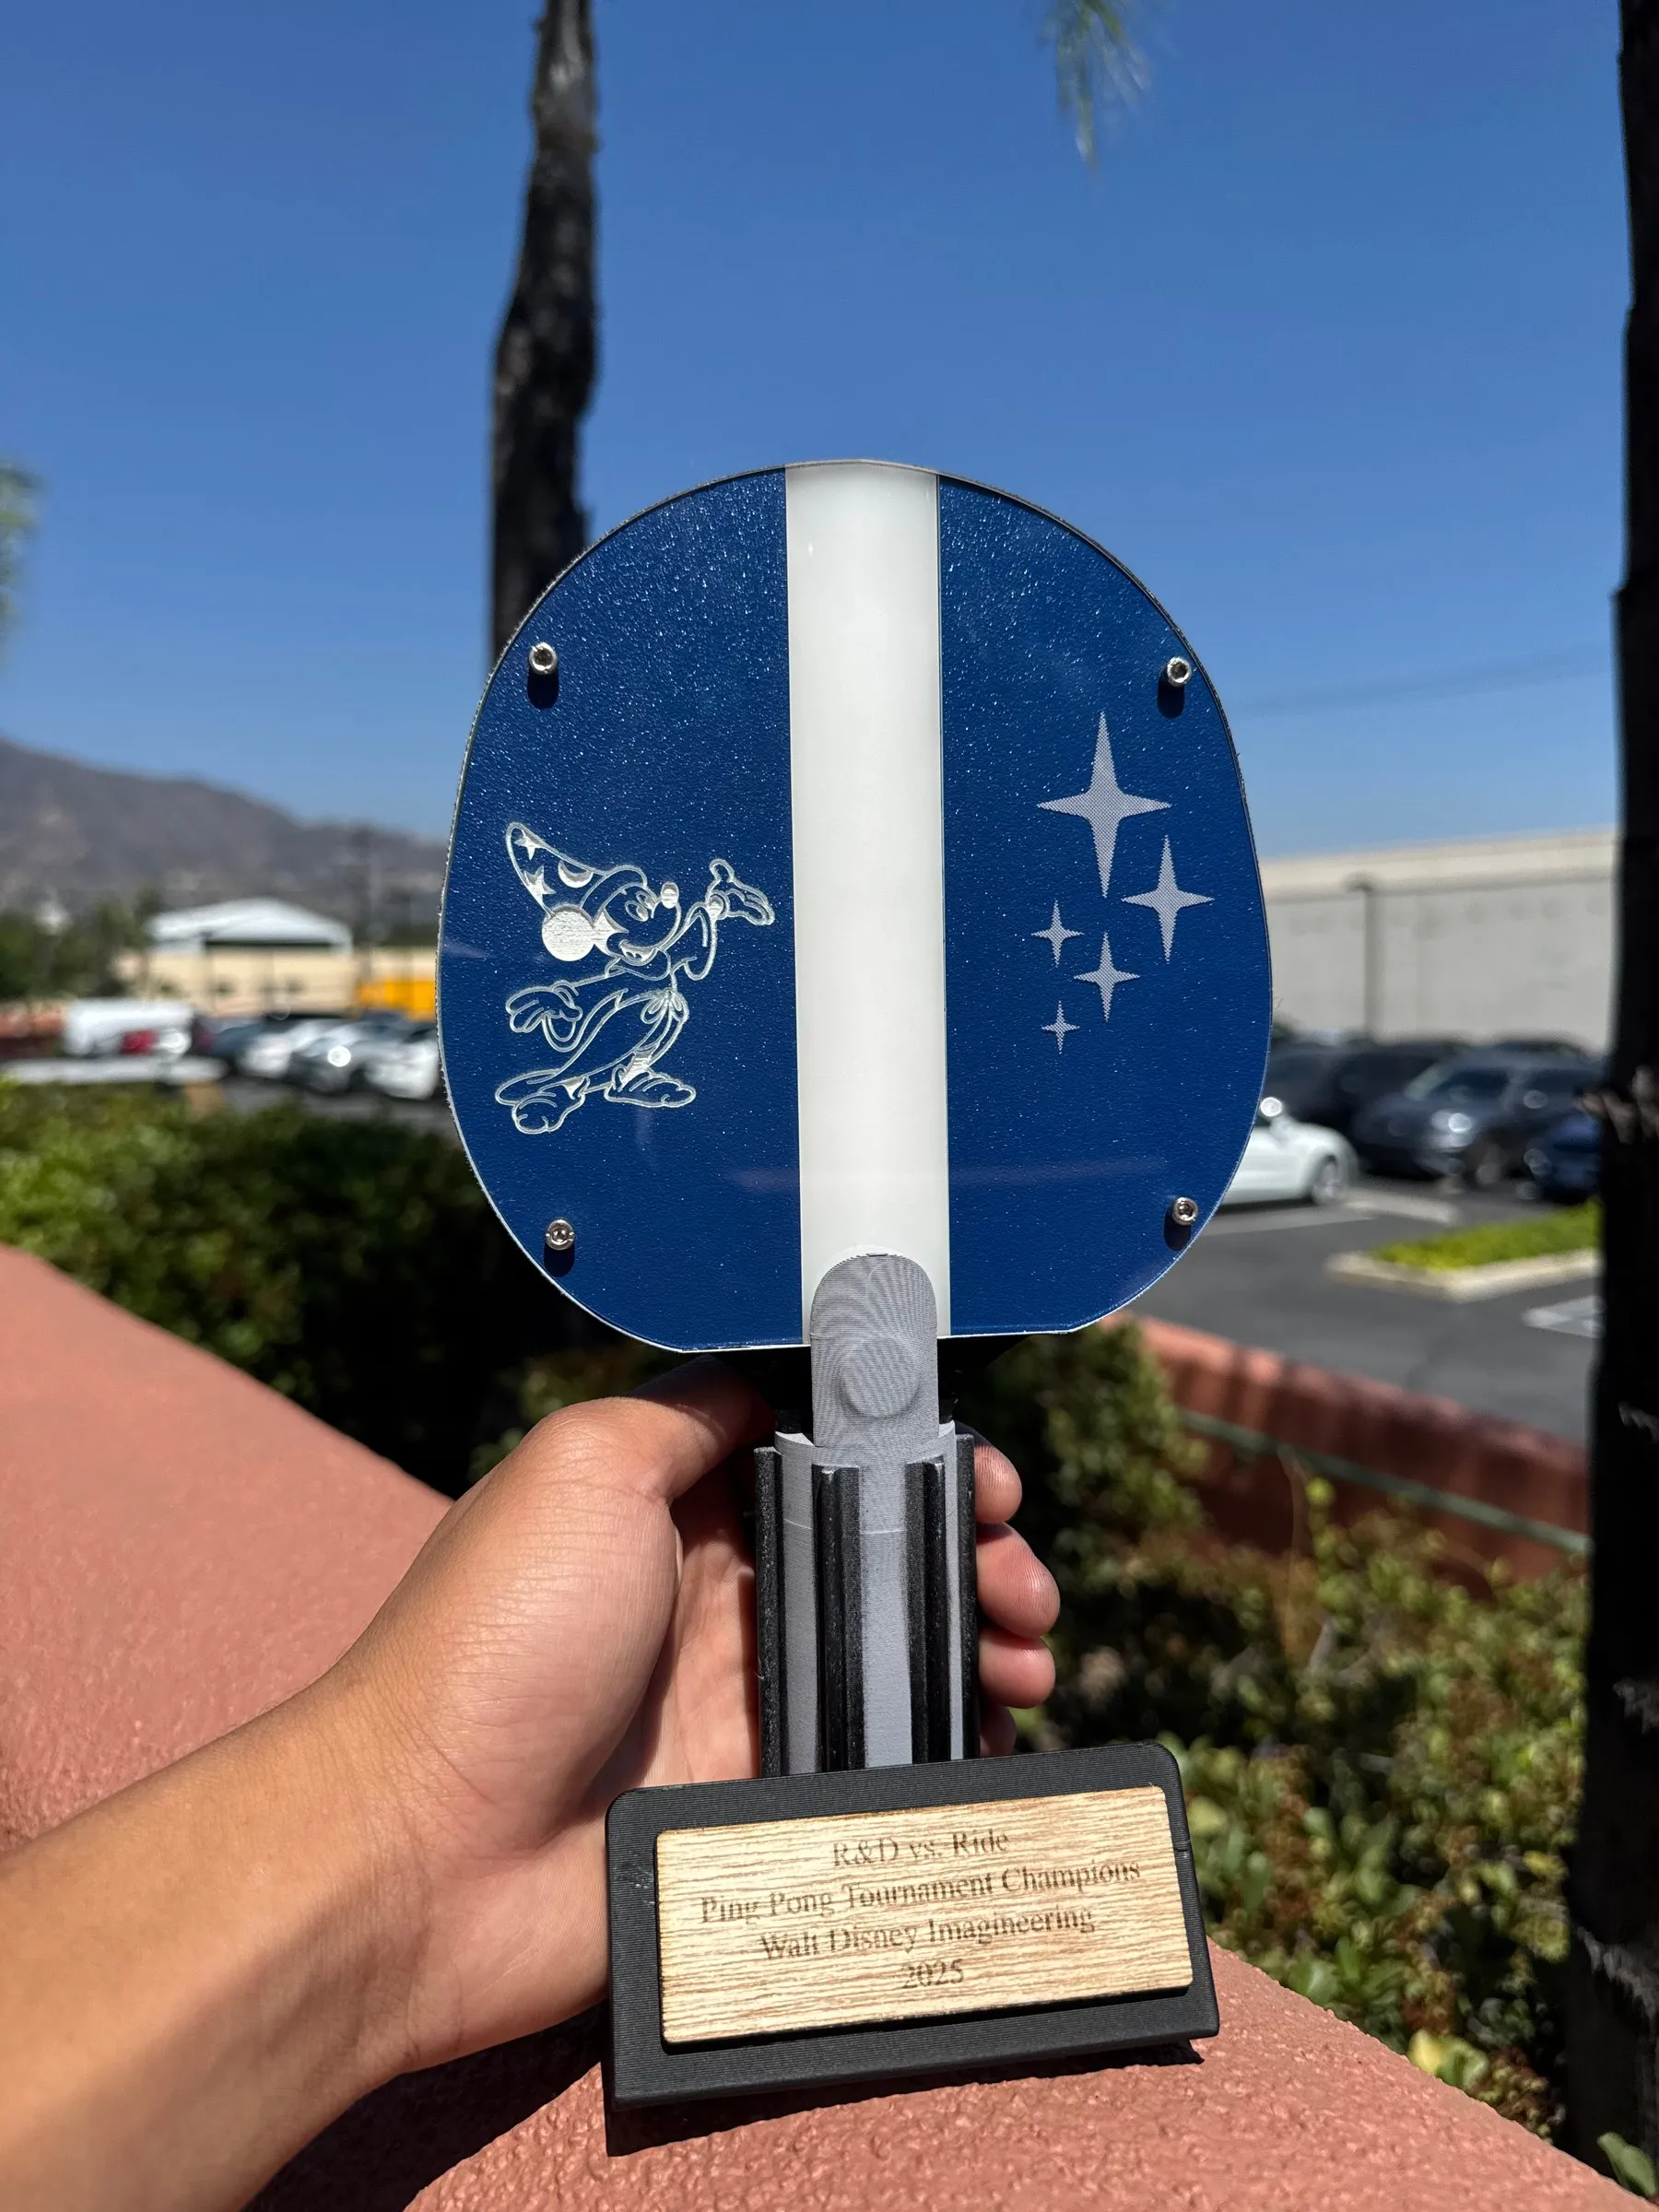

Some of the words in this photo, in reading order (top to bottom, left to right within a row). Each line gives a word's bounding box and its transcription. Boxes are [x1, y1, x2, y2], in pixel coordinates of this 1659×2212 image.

[832, 1836, 900, 1866] R&D
[908, 1839, 942, 1861] vs.
[952, 1828, 1010, 1855] Ride
[701, 1896, 760, 1924] Ping
[769, 1891, 835, 1919] Pong
[841, 1873, 995, 1910] Tournament
[1001, 1858, 1141, 1894] Champions
[760, 1931, 820, 1960] Walt
[829, 1922, 919, 1955] Disney
[928, 1903, 1097, 1944] Imagineering
[900, 1958, 965, 1990] 2025
